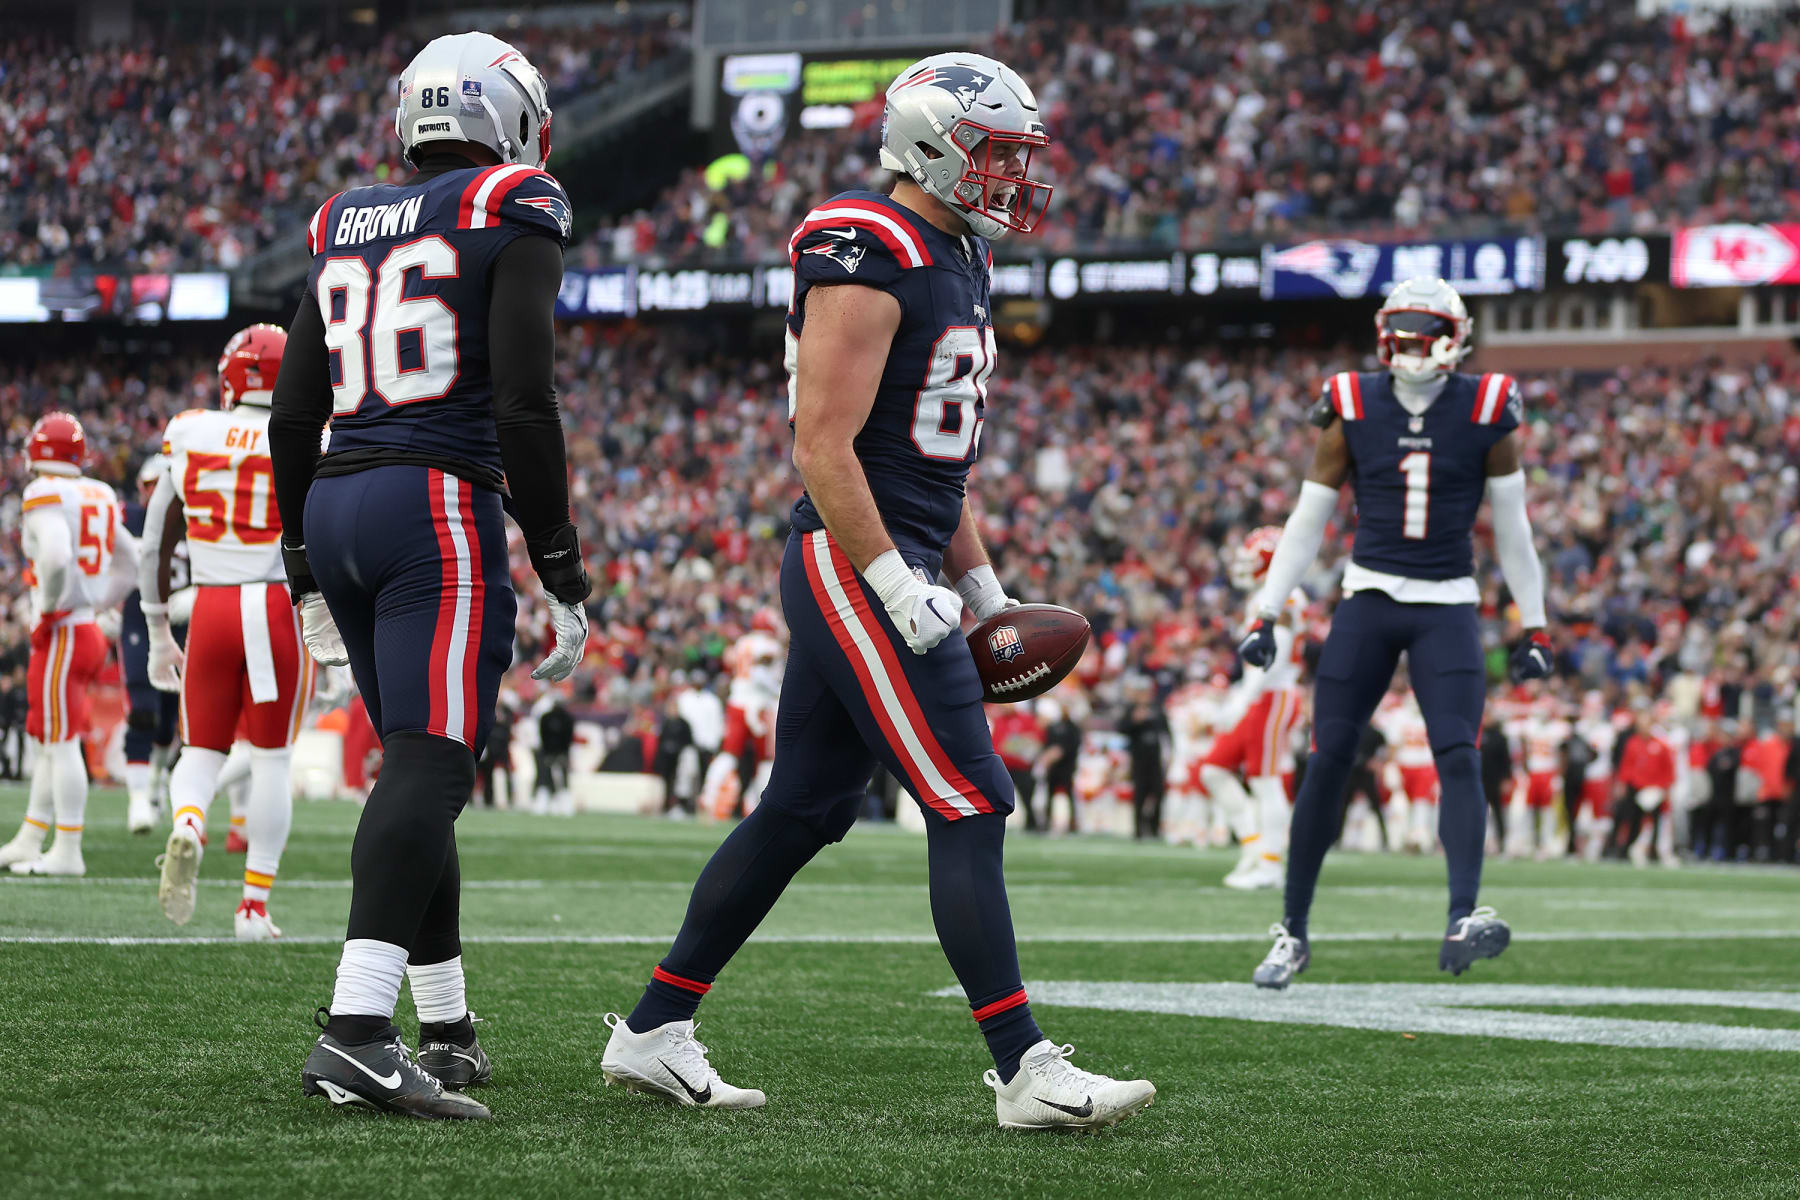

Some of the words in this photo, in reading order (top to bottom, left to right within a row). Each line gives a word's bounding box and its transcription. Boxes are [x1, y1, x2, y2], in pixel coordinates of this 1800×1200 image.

[421, 86, 449, 109] 86
[418, 121, 450, 134] PATRIOTS
[334, 194, 424, 246] BROWN
[1049, 257, 1079, 299] 6
[1190, 252, 1219, 296] 3
[317, 234, 460, 416] 86
[225, 427, 263, 451] GAY
[184, 450, 283, 546] 50
[1398, 450, 1431, 540] 1
[992, 629, 1017, 649] NFL
[429, 1043, 450, 1051] BUCK
